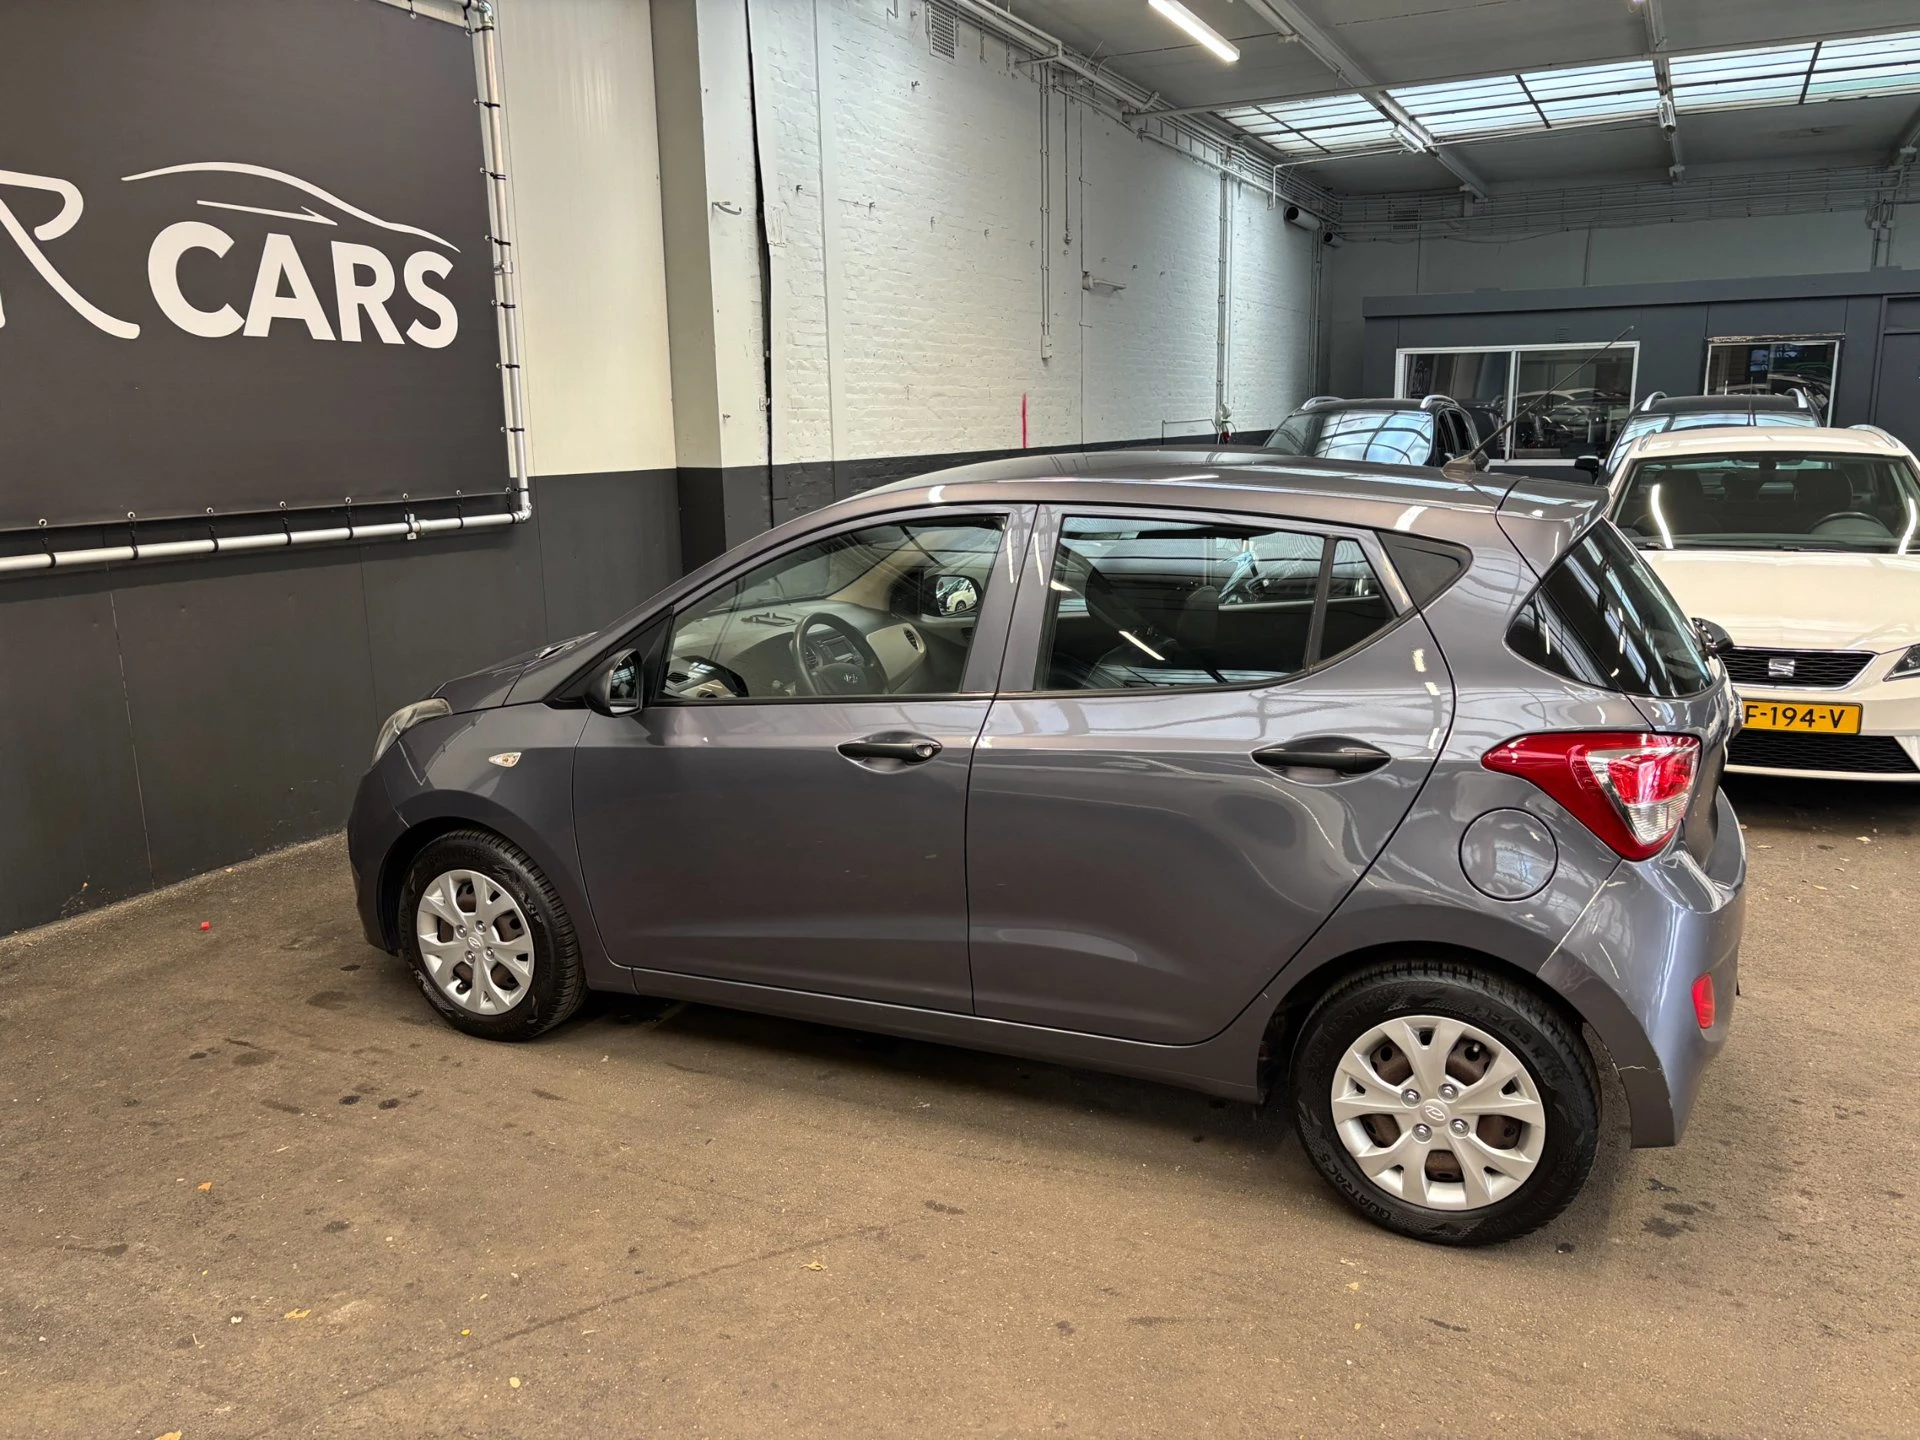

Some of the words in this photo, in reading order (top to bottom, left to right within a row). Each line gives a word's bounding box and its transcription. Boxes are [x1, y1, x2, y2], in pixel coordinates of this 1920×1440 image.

[147, 221, 459, 348] CARS
[1745, 704, 1845, 729] F-194-V
[1327, 1163, 1391, 1219] QUATRAC
